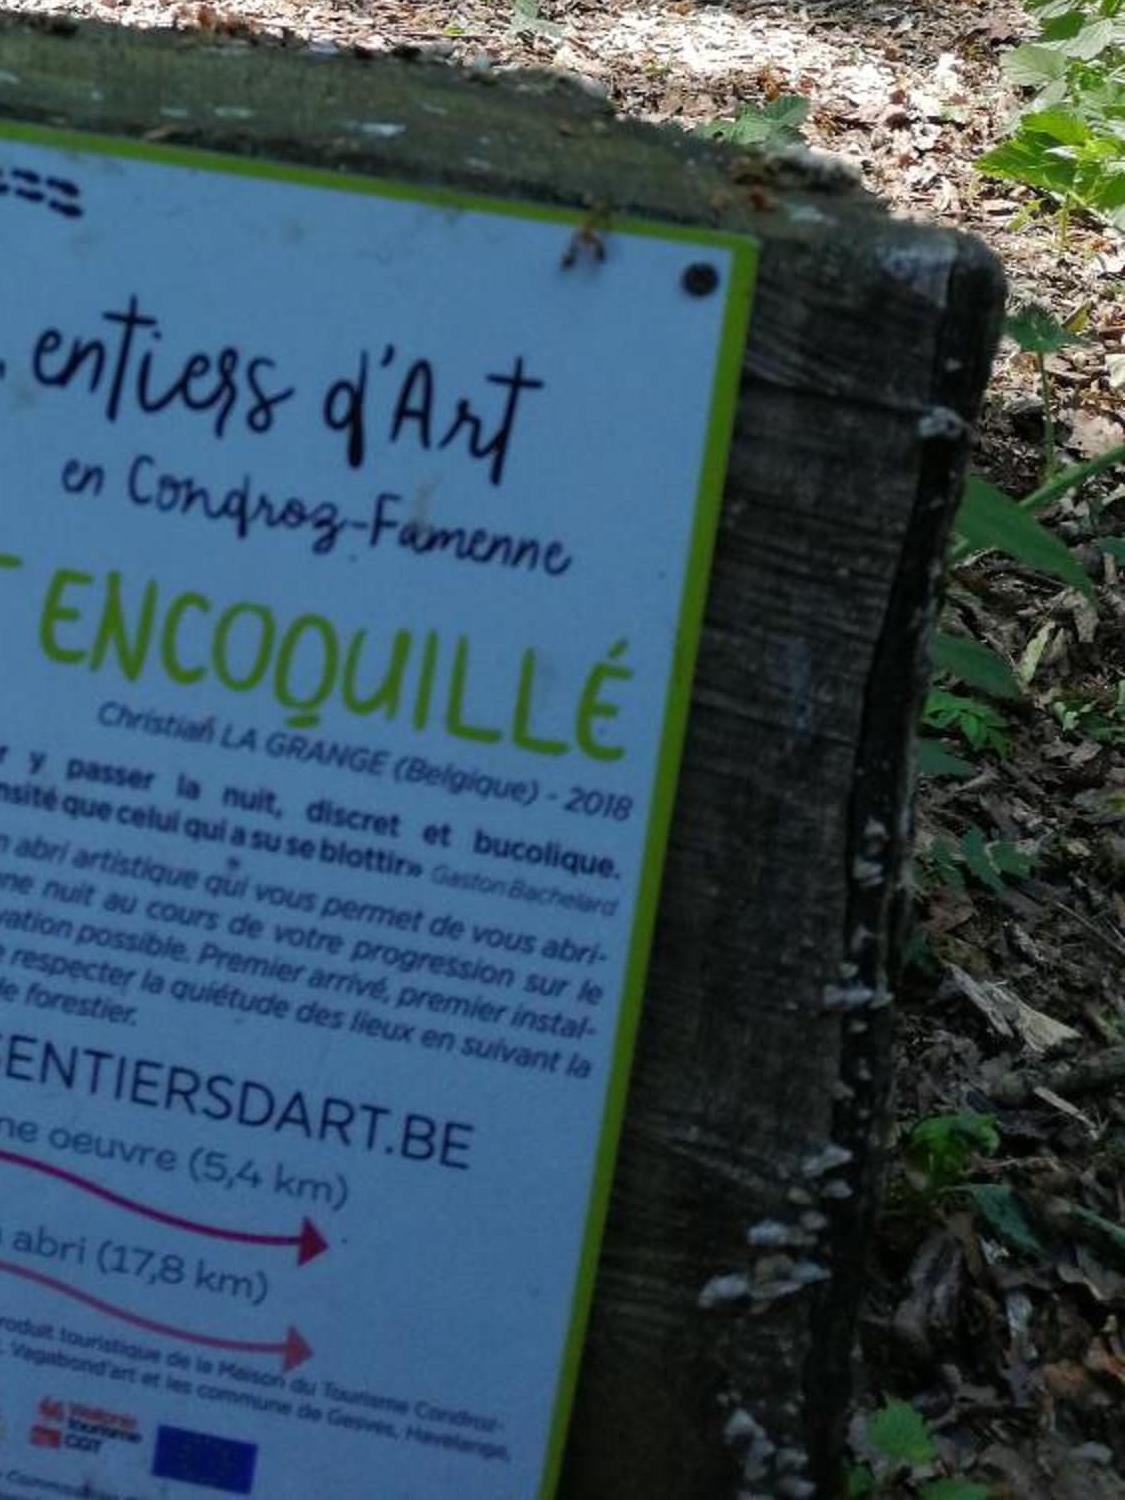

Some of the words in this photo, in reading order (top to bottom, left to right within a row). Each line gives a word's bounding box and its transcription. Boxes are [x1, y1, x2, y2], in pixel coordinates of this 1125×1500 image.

[321, 343, 547, 488] d'Art
[60, 458, 106, 497] en
[127, 453, 573, 577] Condroz-Famenne
[37, 567, 635, 764] ENCOQUILLÉ
[29, 750, 47, 776] y
[65, 757, 156, 791] passer
[175, 772, 202, 801] la
[221, 786, 283, 820] nuit,
[305, 798, 402, 839] discret
[421, 823, 452, 848] et
[472, 828, 621, 881] bucolique.
[60, 794, 114, 822] que
[115, 804, 181, 834] celui
[182, 817, 228, 843] qui
[229, 826, 248, 847] a
[249, 829, 282, 854] su
[285, 835, 317, 860] se
[13, 835, 71, 865] abri
[70, 848, 200, 891] artistique
[202, 866, 251, 900] qui
[254, 883, 318, 913] vous
[319, 895, 426, 933] permet
[427, 914, 466, 942] de
[471, 924, 538, 956] vous
[540, 937, 608, 966] abri-
[40, 879, 97, 908] nuit
[101, 891, 139, 916] au
[144, 899, 221, 932] cours
[227, 912, 265, 940] de
[273, 924, 346, 956] votre
[349, 939, 516, 989] progression
[522, 973, 571, 998] sur
[576, 978, 605, 1006] le
[9, 947, 138, 994] respecter
[139, 967, 166, 995] la
[169, 978, 291, 1020] quiétude
[294, 1000, 346, 1031] des
[348, 1009, 417, 1044] lieux
[419, 1028, 457, 1052] en
[460, 1036, 563, 1074] suivant
[564, 1052, 593, 1080] la
[23, 981, 138, 1027] forestier.
[74, 923, 190, 964] possible.
[196, 941, 307, 984] Premier
[306, 967, 391, 1005] arrivé,
[394, 986, 509, 1024] premier
[509, 1003, 597, 1041] instal-
[47, 1126, 178, 1173] oeuvre
[187, 1145, 264, 1191] (5,4
[272, 1162, 350, 1213] km)
[11, 1224, 87, 1266] abri
[96, 1239, 186, 1286] (17,8
[193, 1257, 270, 1307] km)
